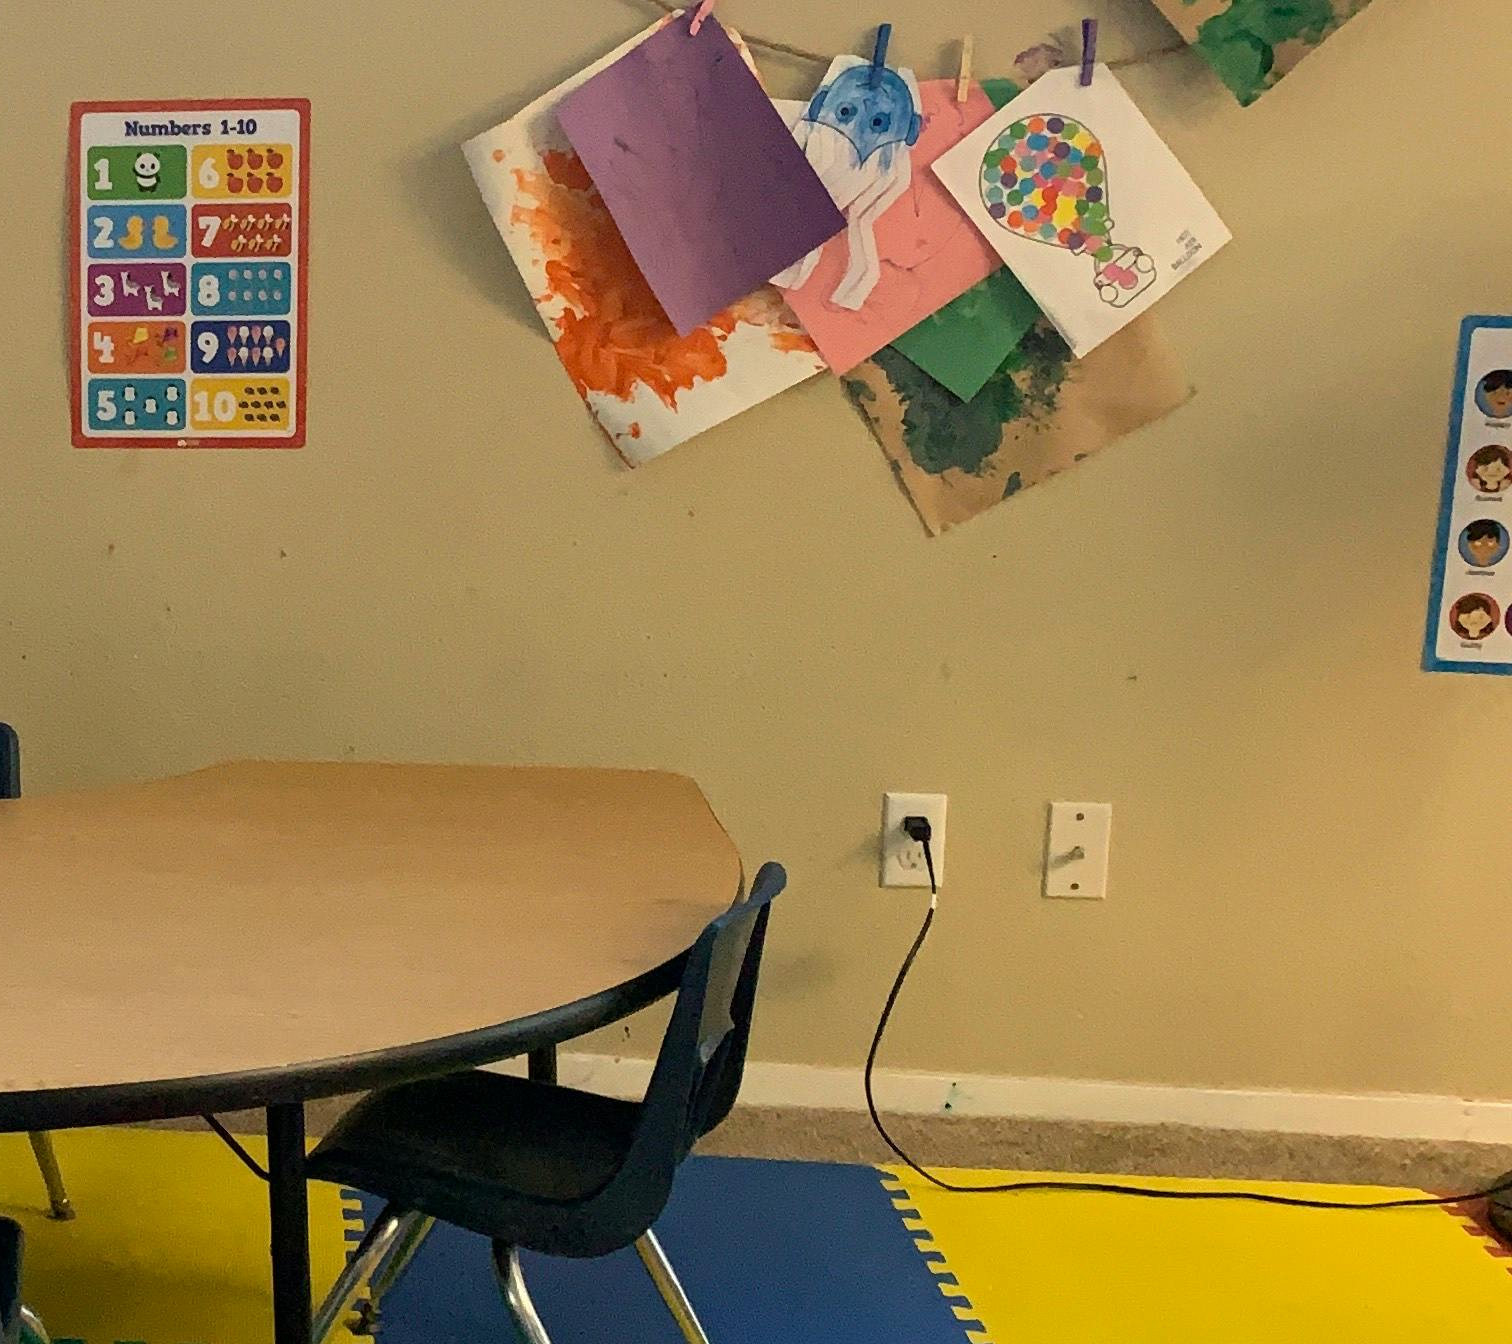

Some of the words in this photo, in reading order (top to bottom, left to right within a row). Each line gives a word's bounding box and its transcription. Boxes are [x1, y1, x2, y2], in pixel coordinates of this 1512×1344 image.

[124, 120, 211, 137] Numbers
[221, 118, 258, 135] 1-10
[94, 158, 112, 190] 1
[199, 157, 220, 189] 6
[93, 216, 114, 249] 2
[198, 216, 222, 248] 7
[94, 274, 115, 306] 3
[197, 274, 220, 307] 8
[93, 331, 115, 364] 4
[197, 331, 219, 364] 9
[96, 389, 117, 421] 5
[194, 390, 237, 422] 10
